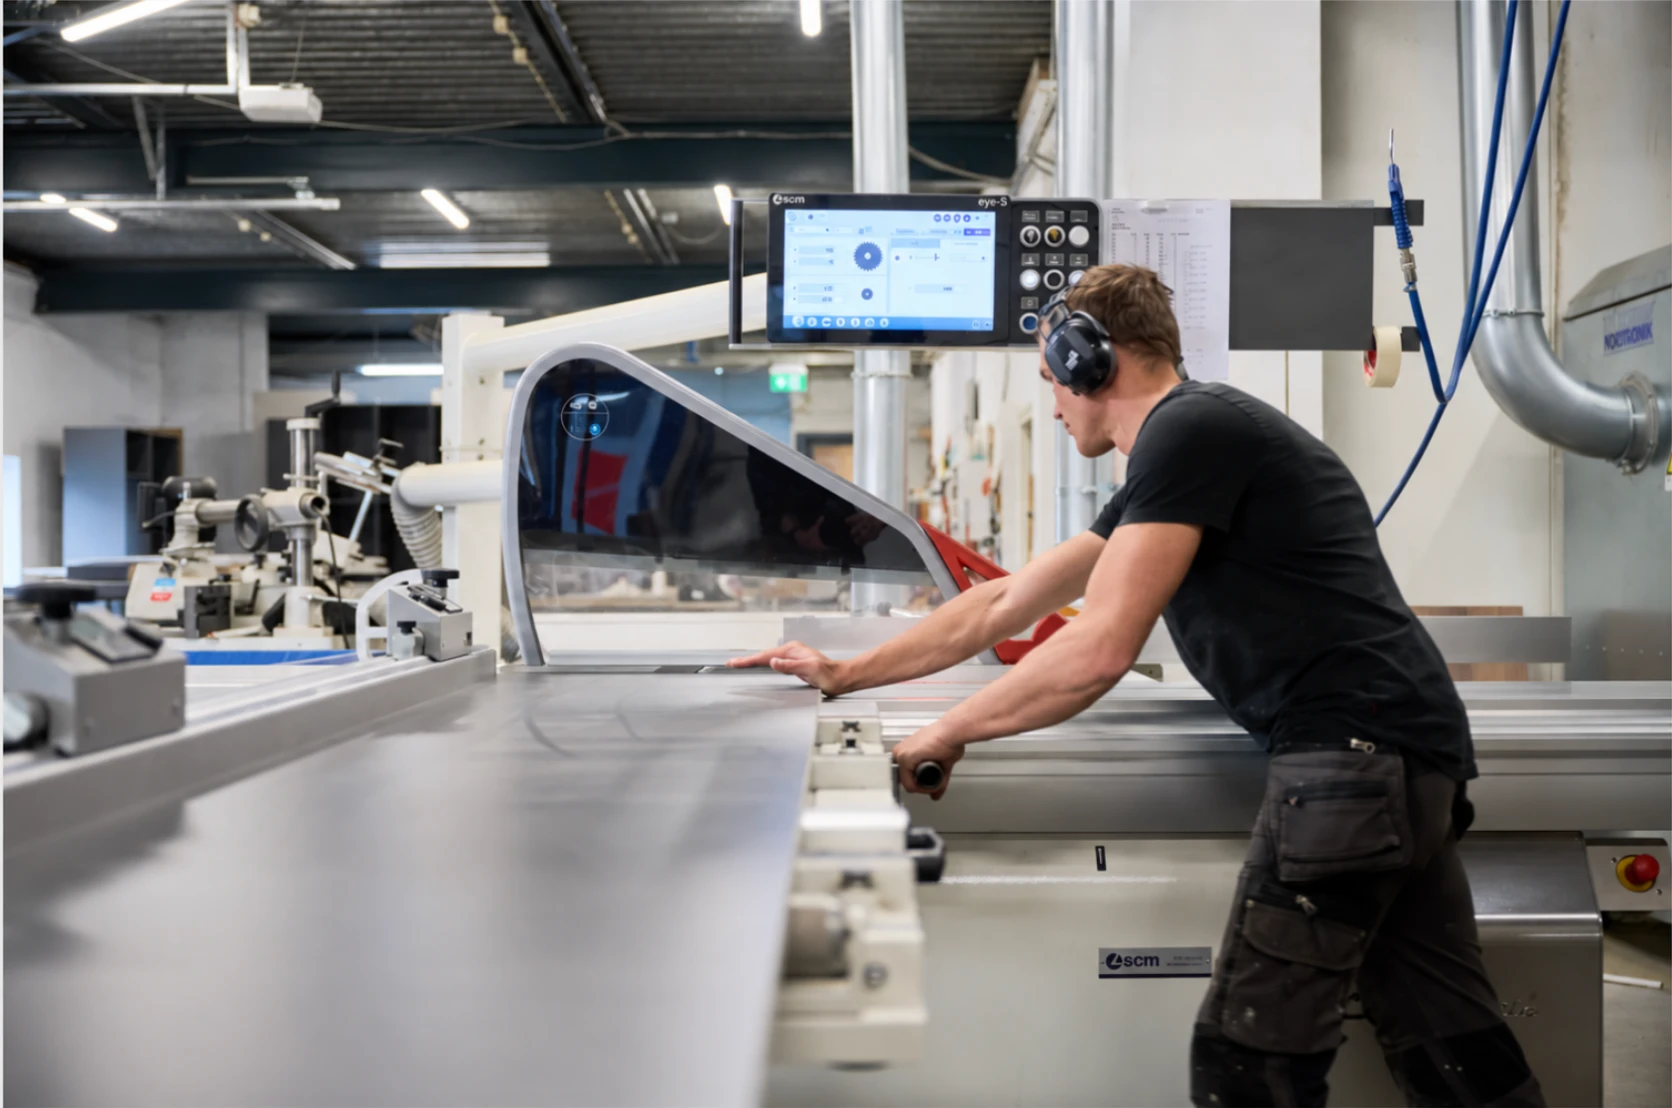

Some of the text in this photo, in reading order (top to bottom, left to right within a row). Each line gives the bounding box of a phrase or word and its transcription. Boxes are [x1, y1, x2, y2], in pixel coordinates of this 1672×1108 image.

[783, 196, 805, 204] scm
[978, 197, 1008, 209] eye-S
[1123, 955, 1160, 967] scm
